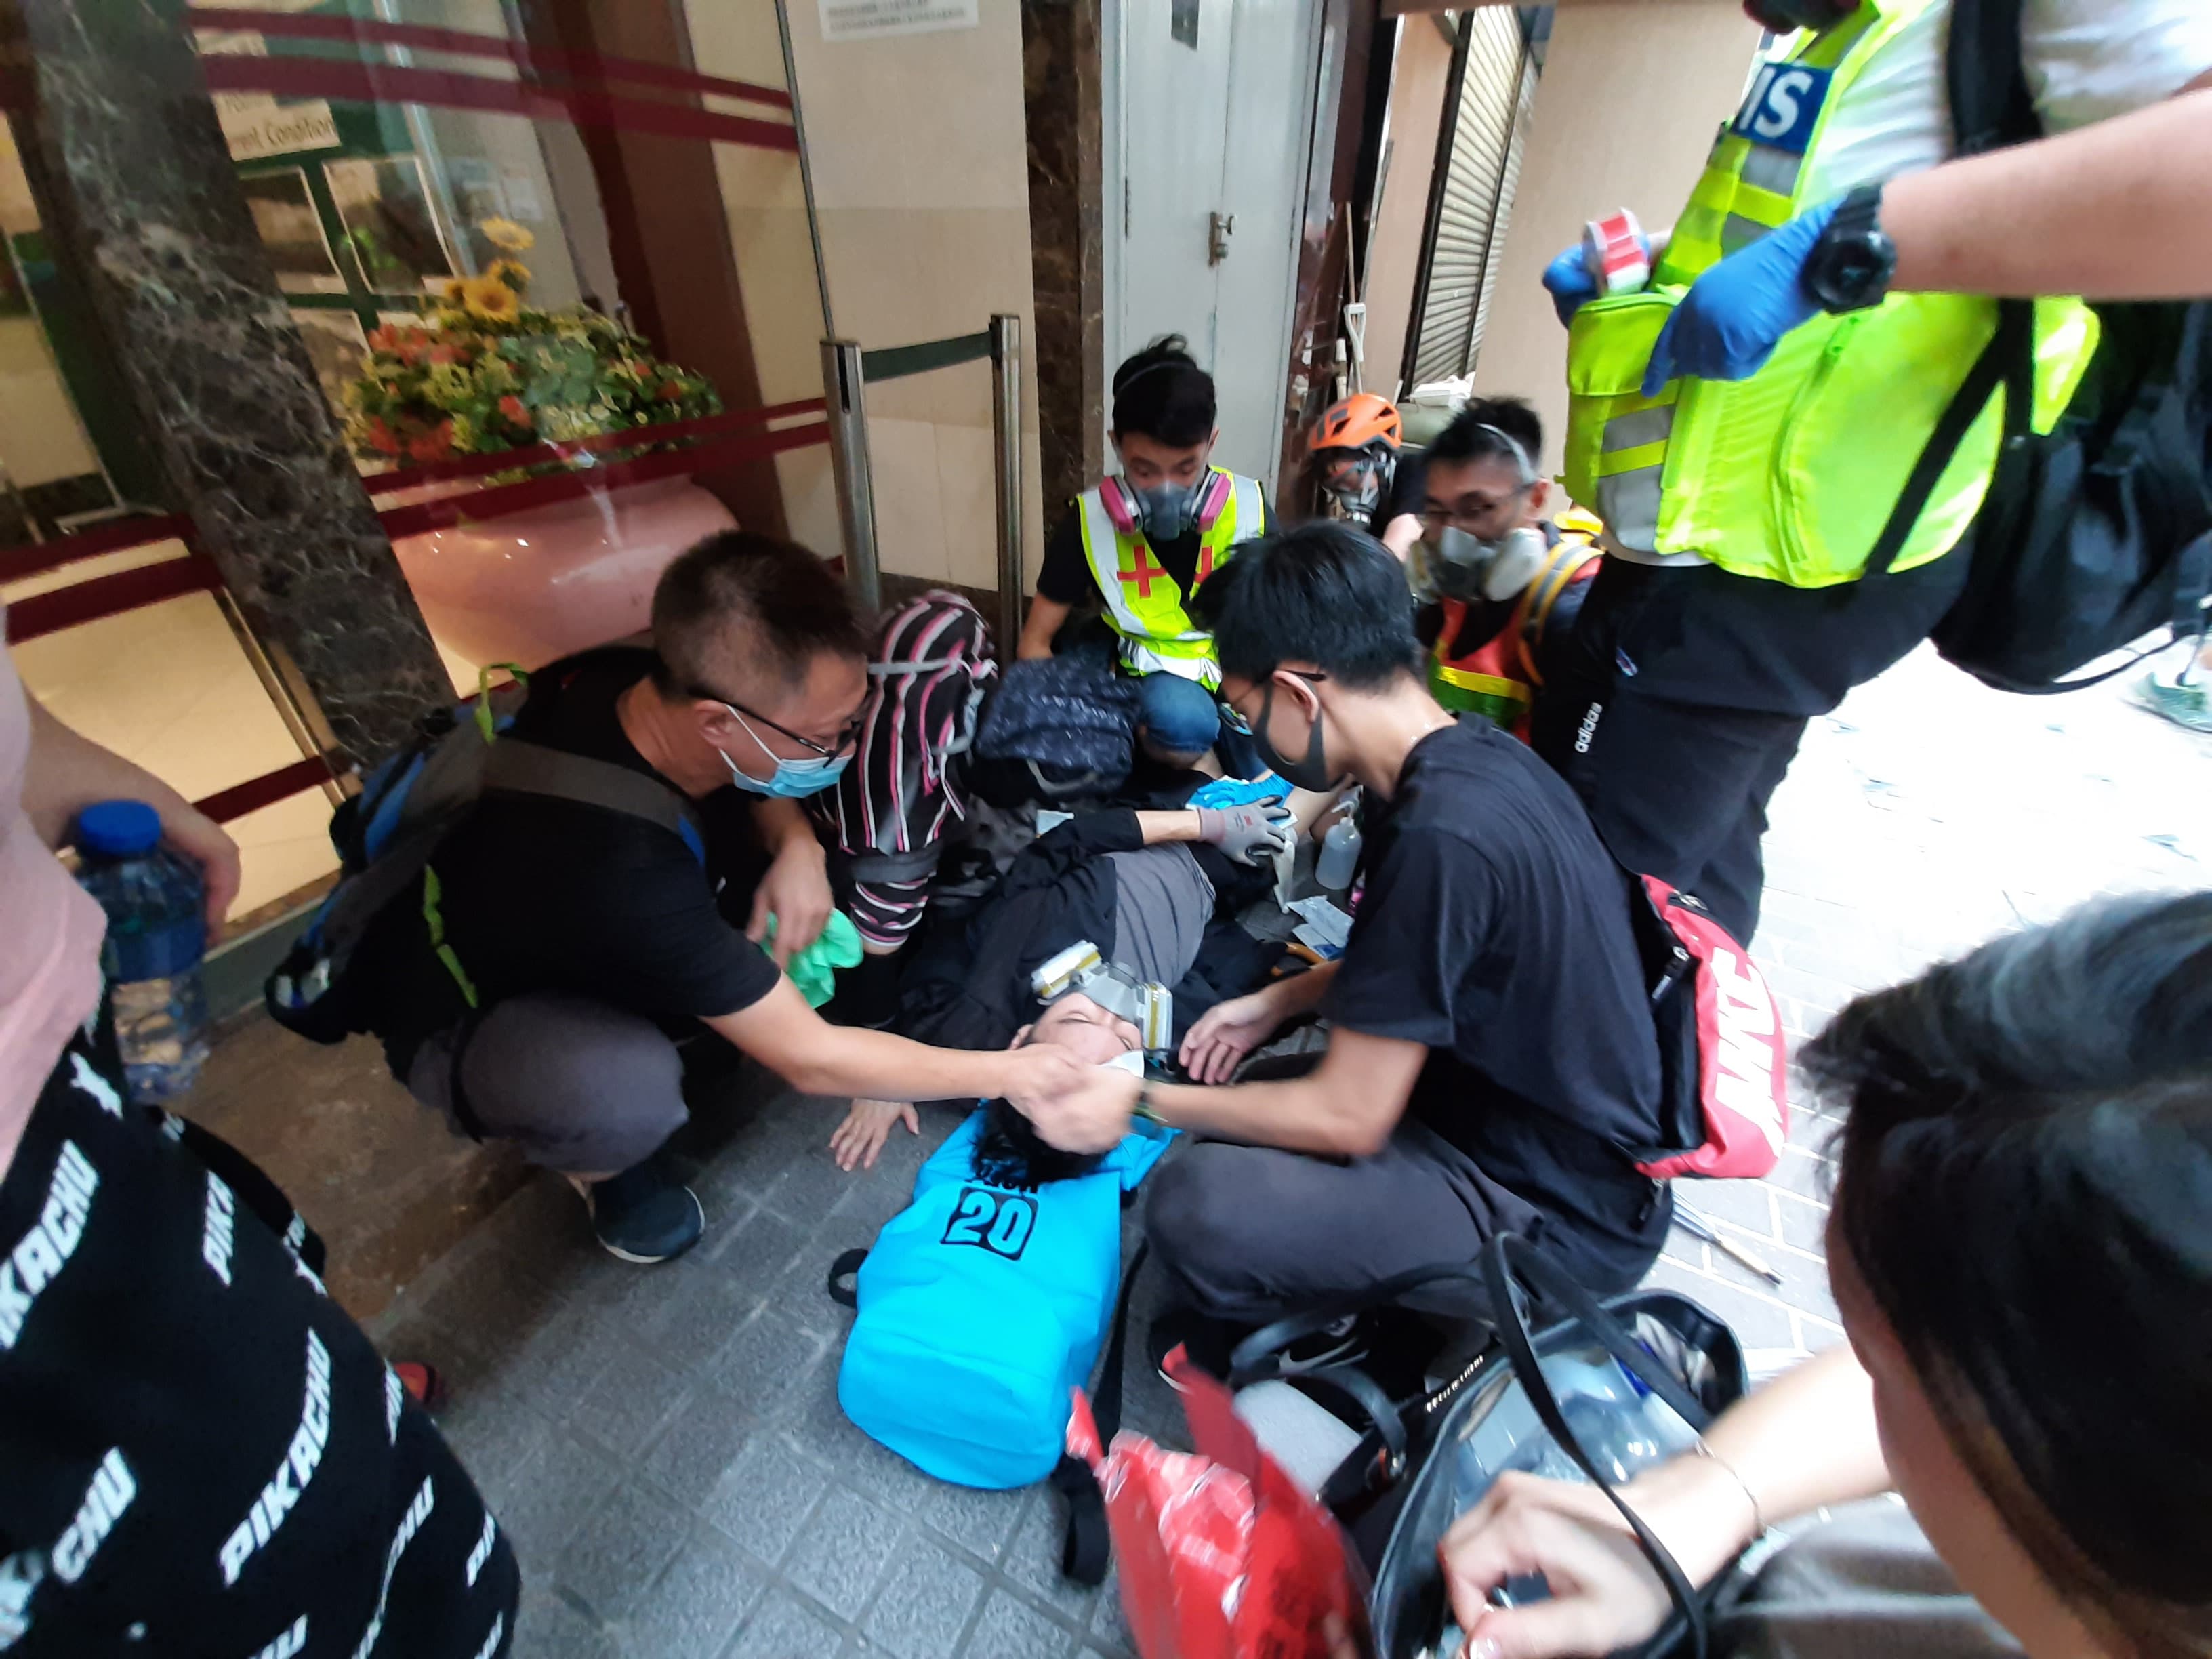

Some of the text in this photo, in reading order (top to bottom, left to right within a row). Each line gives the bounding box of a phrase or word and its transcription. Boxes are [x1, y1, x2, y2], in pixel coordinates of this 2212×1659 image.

[1574, 701, 1603, 753] adidas
[945, 1191, 1033, 1254] 20
[219, 1326, 332, 1588] PIKACHU
